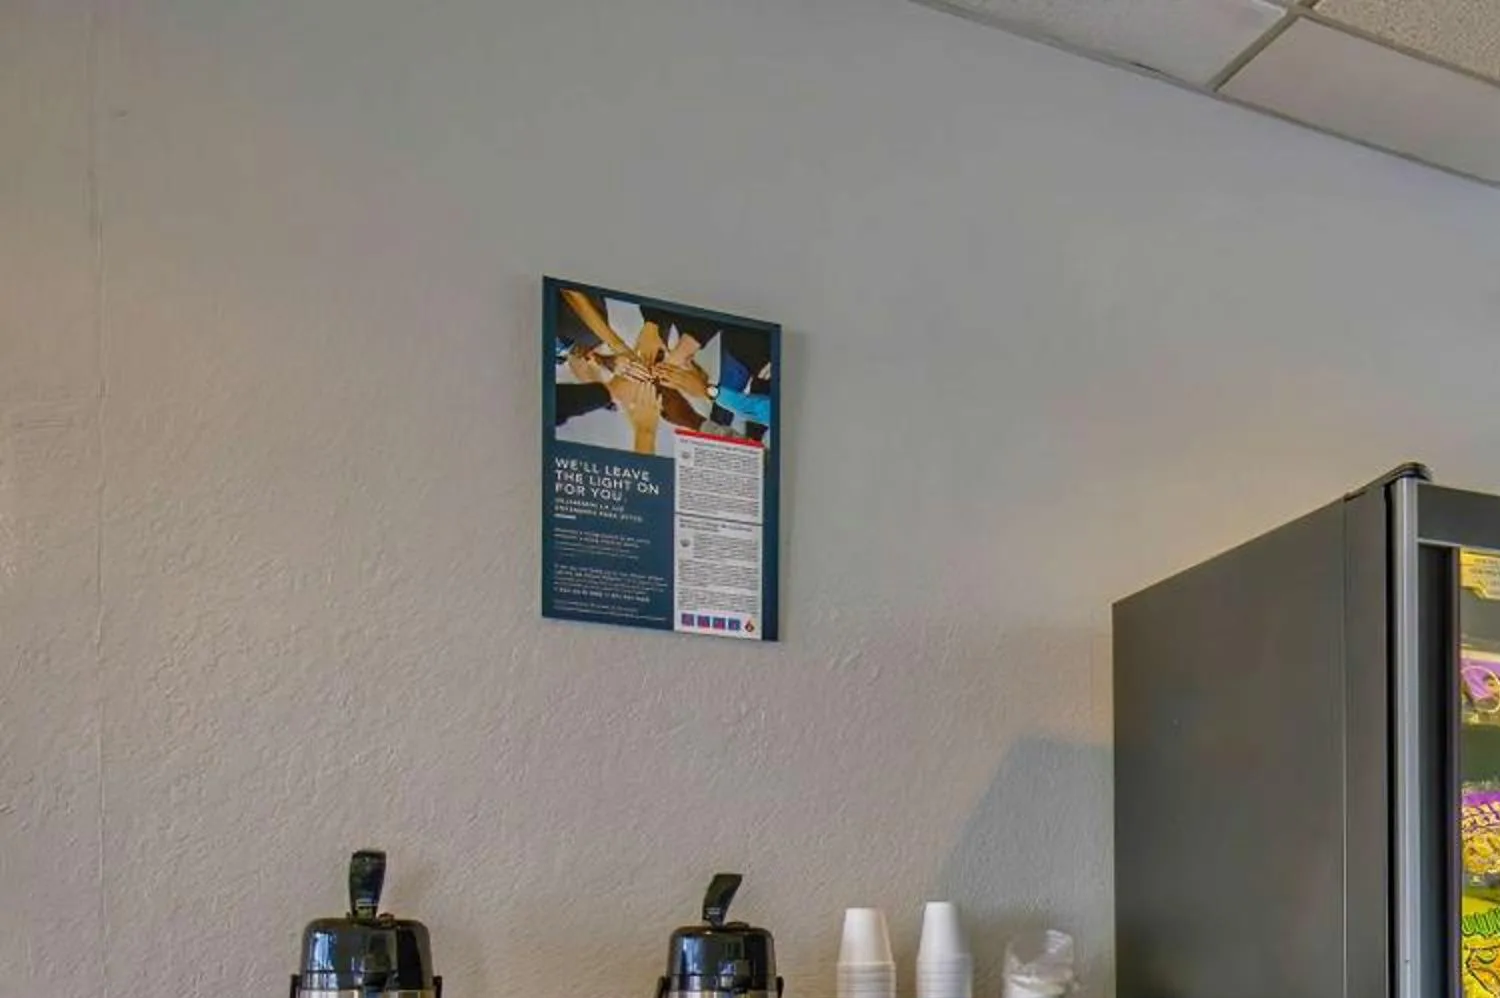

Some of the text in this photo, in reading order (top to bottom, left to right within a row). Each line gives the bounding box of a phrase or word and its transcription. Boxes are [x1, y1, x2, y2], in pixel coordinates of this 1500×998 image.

[555, 457, 650, 481] WE'LL LEAVE
[555, 469, 659, 495] THE LIGHT ON
[555, 482, 585, 497] FOR
